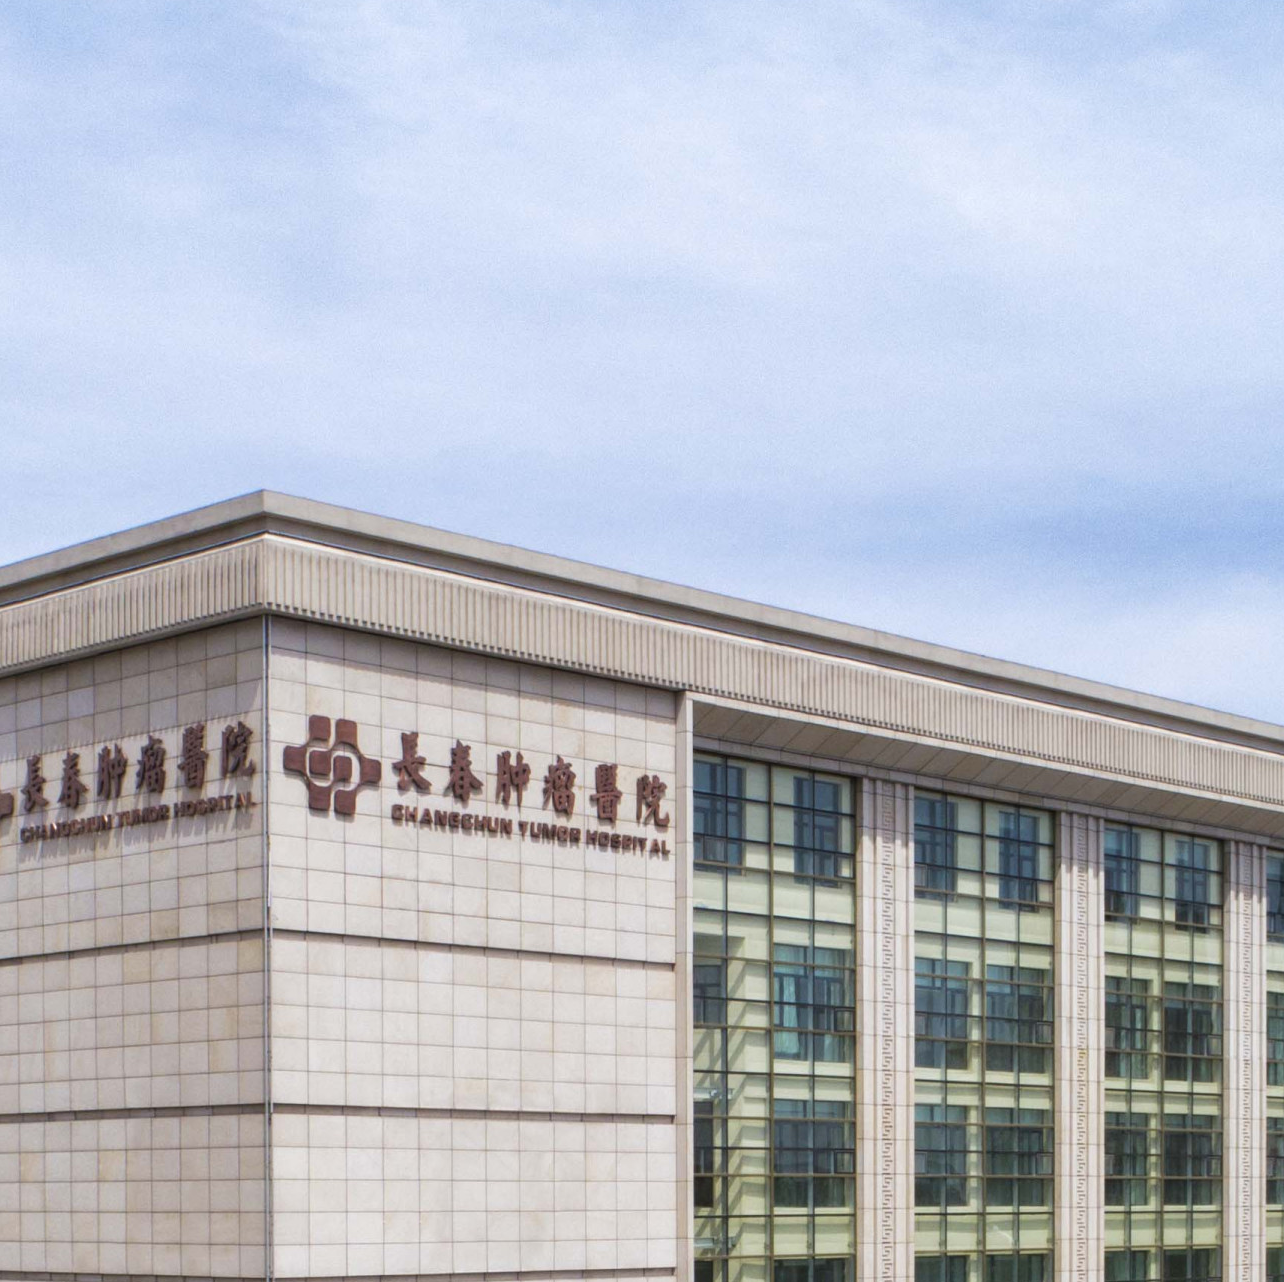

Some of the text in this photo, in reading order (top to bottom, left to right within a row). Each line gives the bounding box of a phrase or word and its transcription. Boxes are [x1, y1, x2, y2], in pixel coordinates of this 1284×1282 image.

[20, 791, 257, 844] CHANGCHUN TUMOR HOSPITAL
[391, 804, 671, 856] CHANGCHUN TUMOR HOSPITAL
